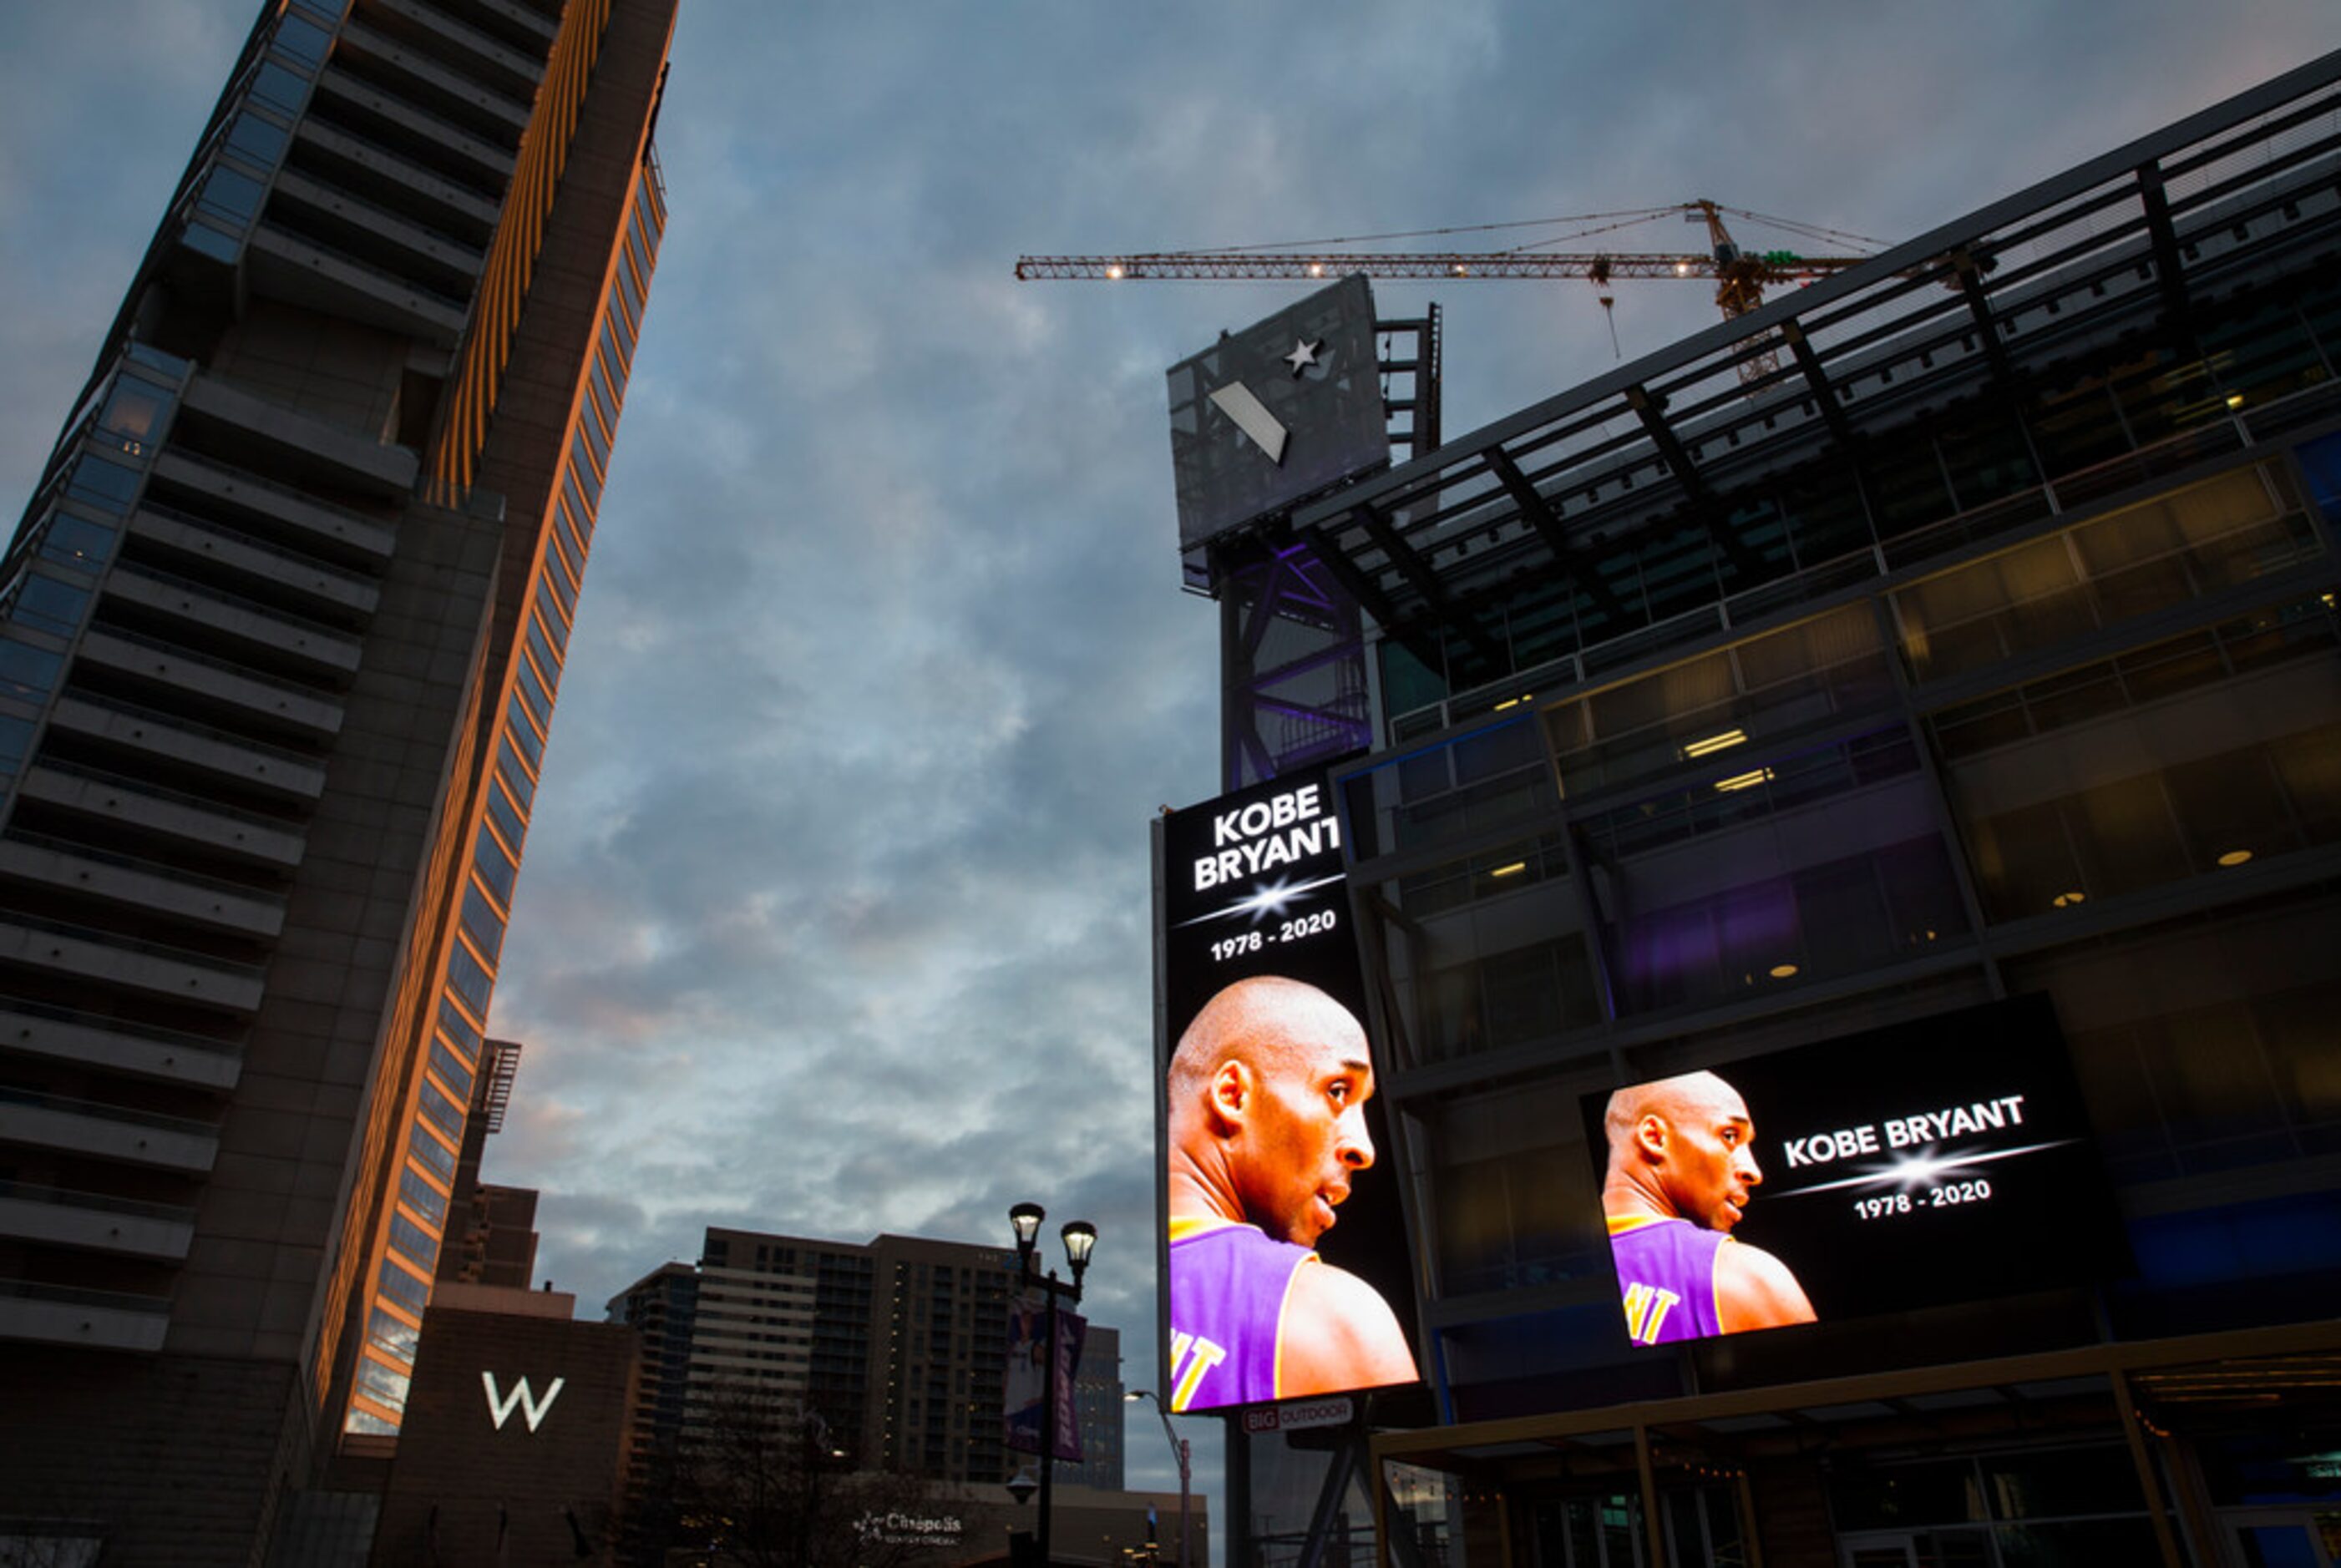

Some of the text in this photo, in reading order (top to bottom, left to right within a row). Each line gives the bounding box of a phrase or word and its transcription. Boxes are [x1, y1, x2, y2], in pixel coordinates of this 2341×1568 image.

[1214, 783, 1321, 847] KOBE
[1194, 816, 1341, 892] BRYANT
[1210, 931, 1263, 961] 1978
[1280, 909, 1336, 943] 2020
[1784, 1095, 2024, 1168] KOBE BRYANT
[1854, 1191, 1912, 1220] 1978
[1931, 1179, 1991, 1207] 2020
[481, 1370, 566, 1434] W
[1247, 1404, 1348, 1429] BIG OUTDOOR
